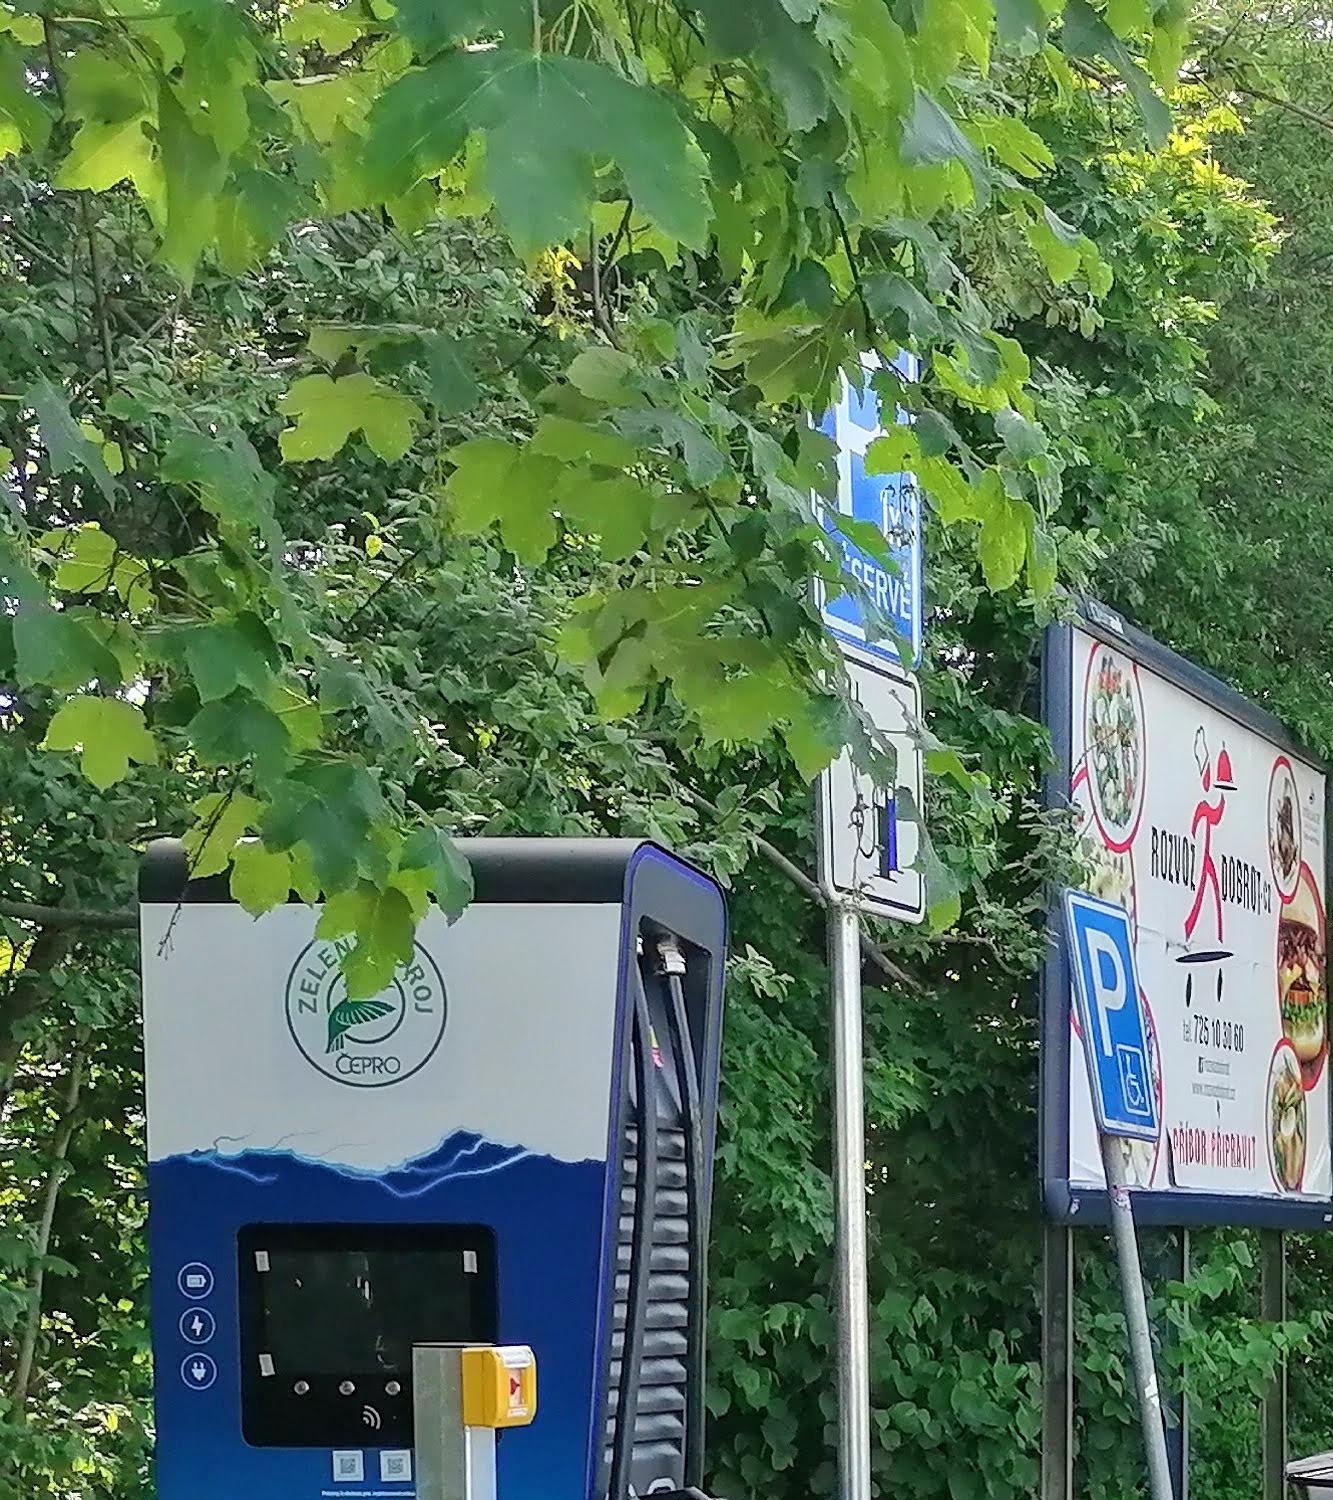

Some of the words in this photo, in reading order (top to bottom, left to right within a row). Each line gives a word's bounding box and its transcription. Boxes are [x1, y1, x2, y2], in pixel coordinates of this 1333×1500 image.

[1151, 825, 1196, 892] ROZVOZ
[298, 934, 358, 1014] ZELEN
[1085, 926, 1130, 1058] P
[1193, 1014, 1209, 1046] 725
[1212, 1018, 1221, 1049] 10
[1233, 1024, 1244, 1053] 60
[335, 1053, 401, 1075] ČEPRO
[1173, 1120, 1207, 1166] PŘÍBOR
